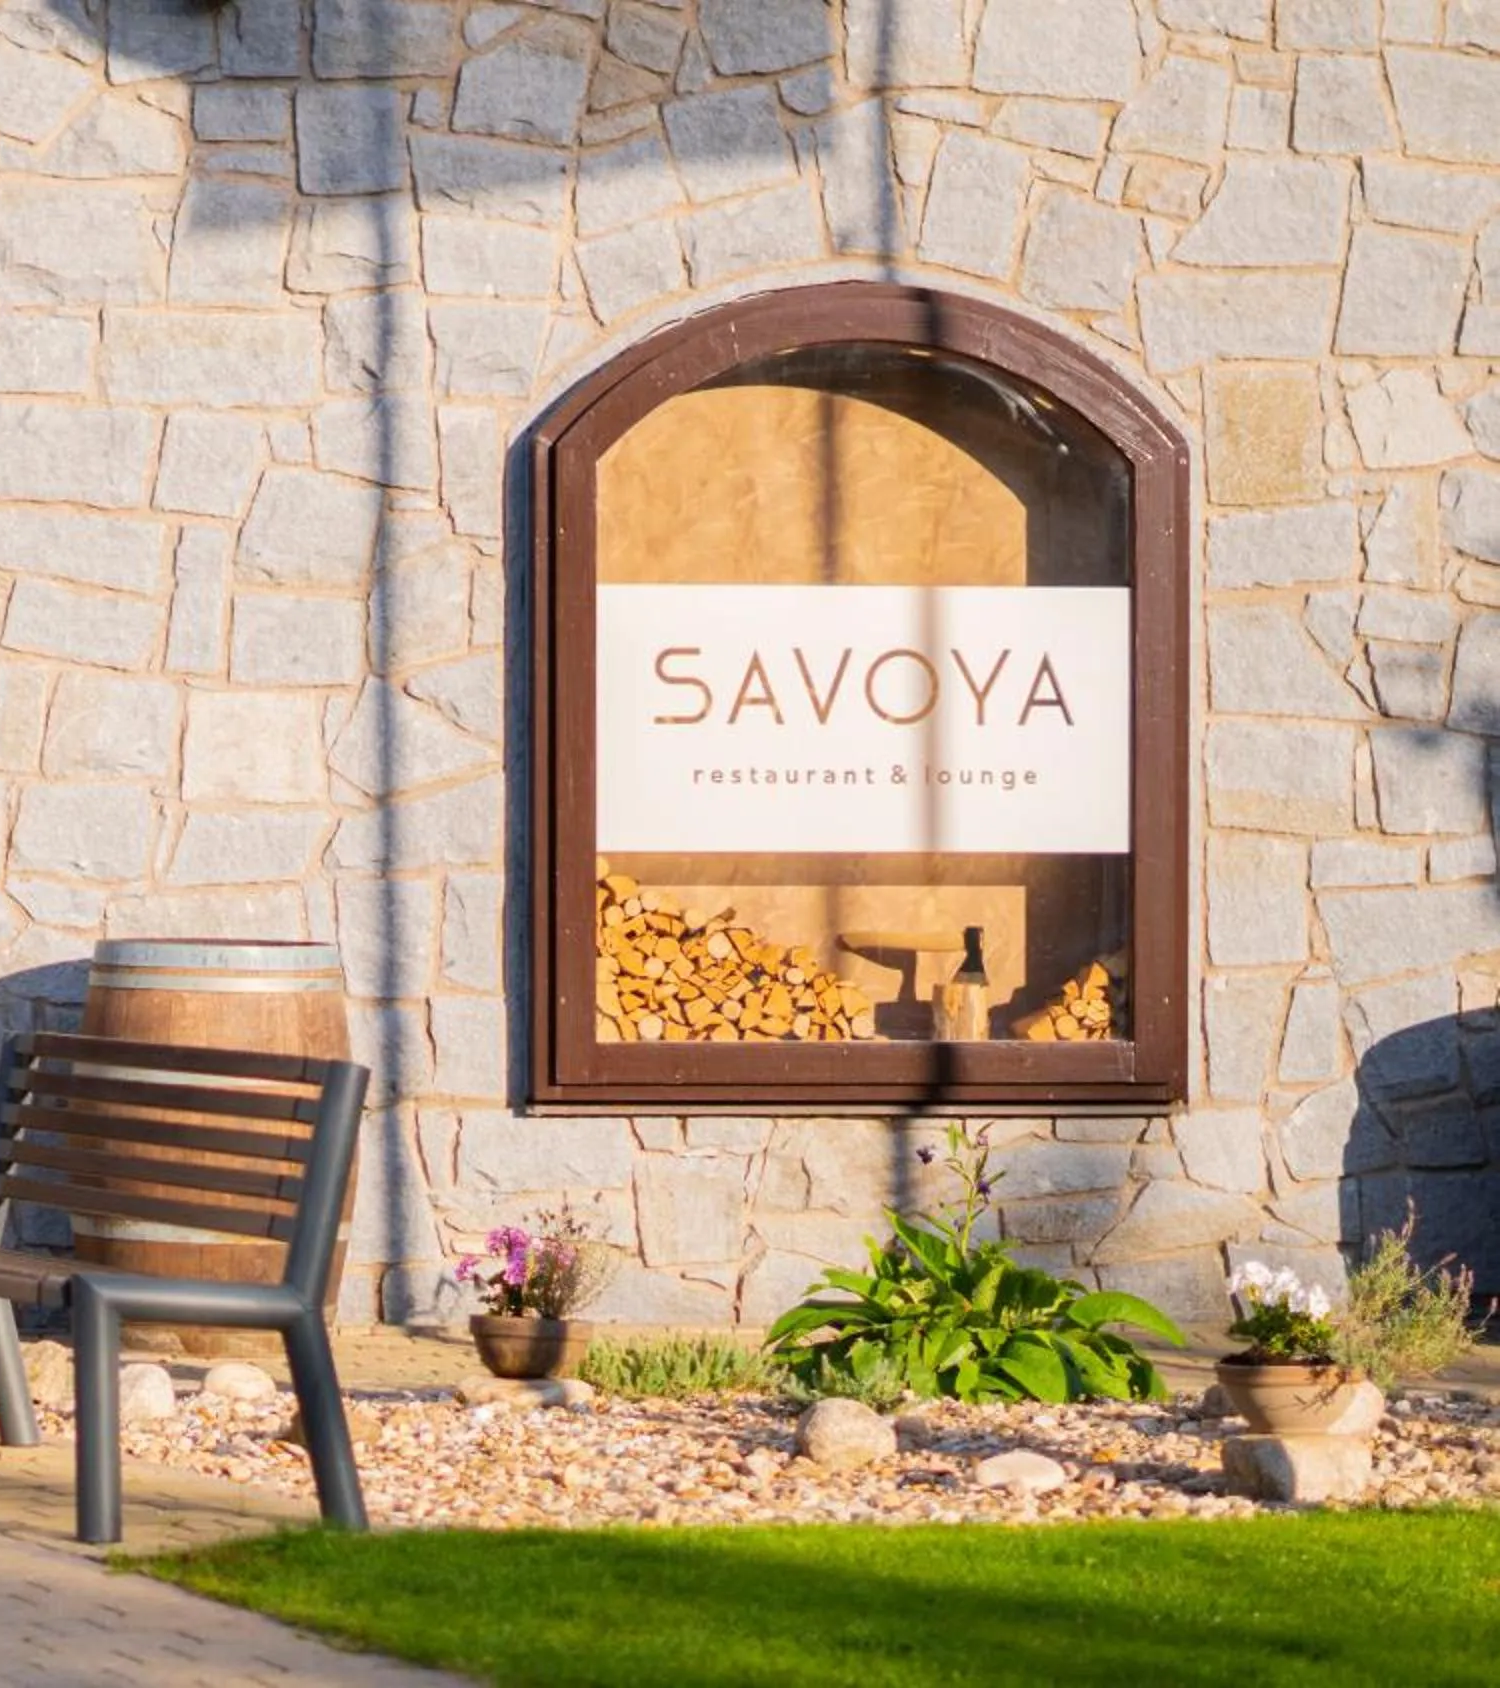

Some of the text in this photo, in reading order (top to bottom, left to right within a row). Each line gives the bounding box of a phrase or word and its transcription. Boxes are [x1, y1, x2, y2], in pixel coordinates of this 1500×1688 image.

[653, 647, 1075, 726] SAVOYA
[693, 764, 1038, 791] restaurant & lounge
